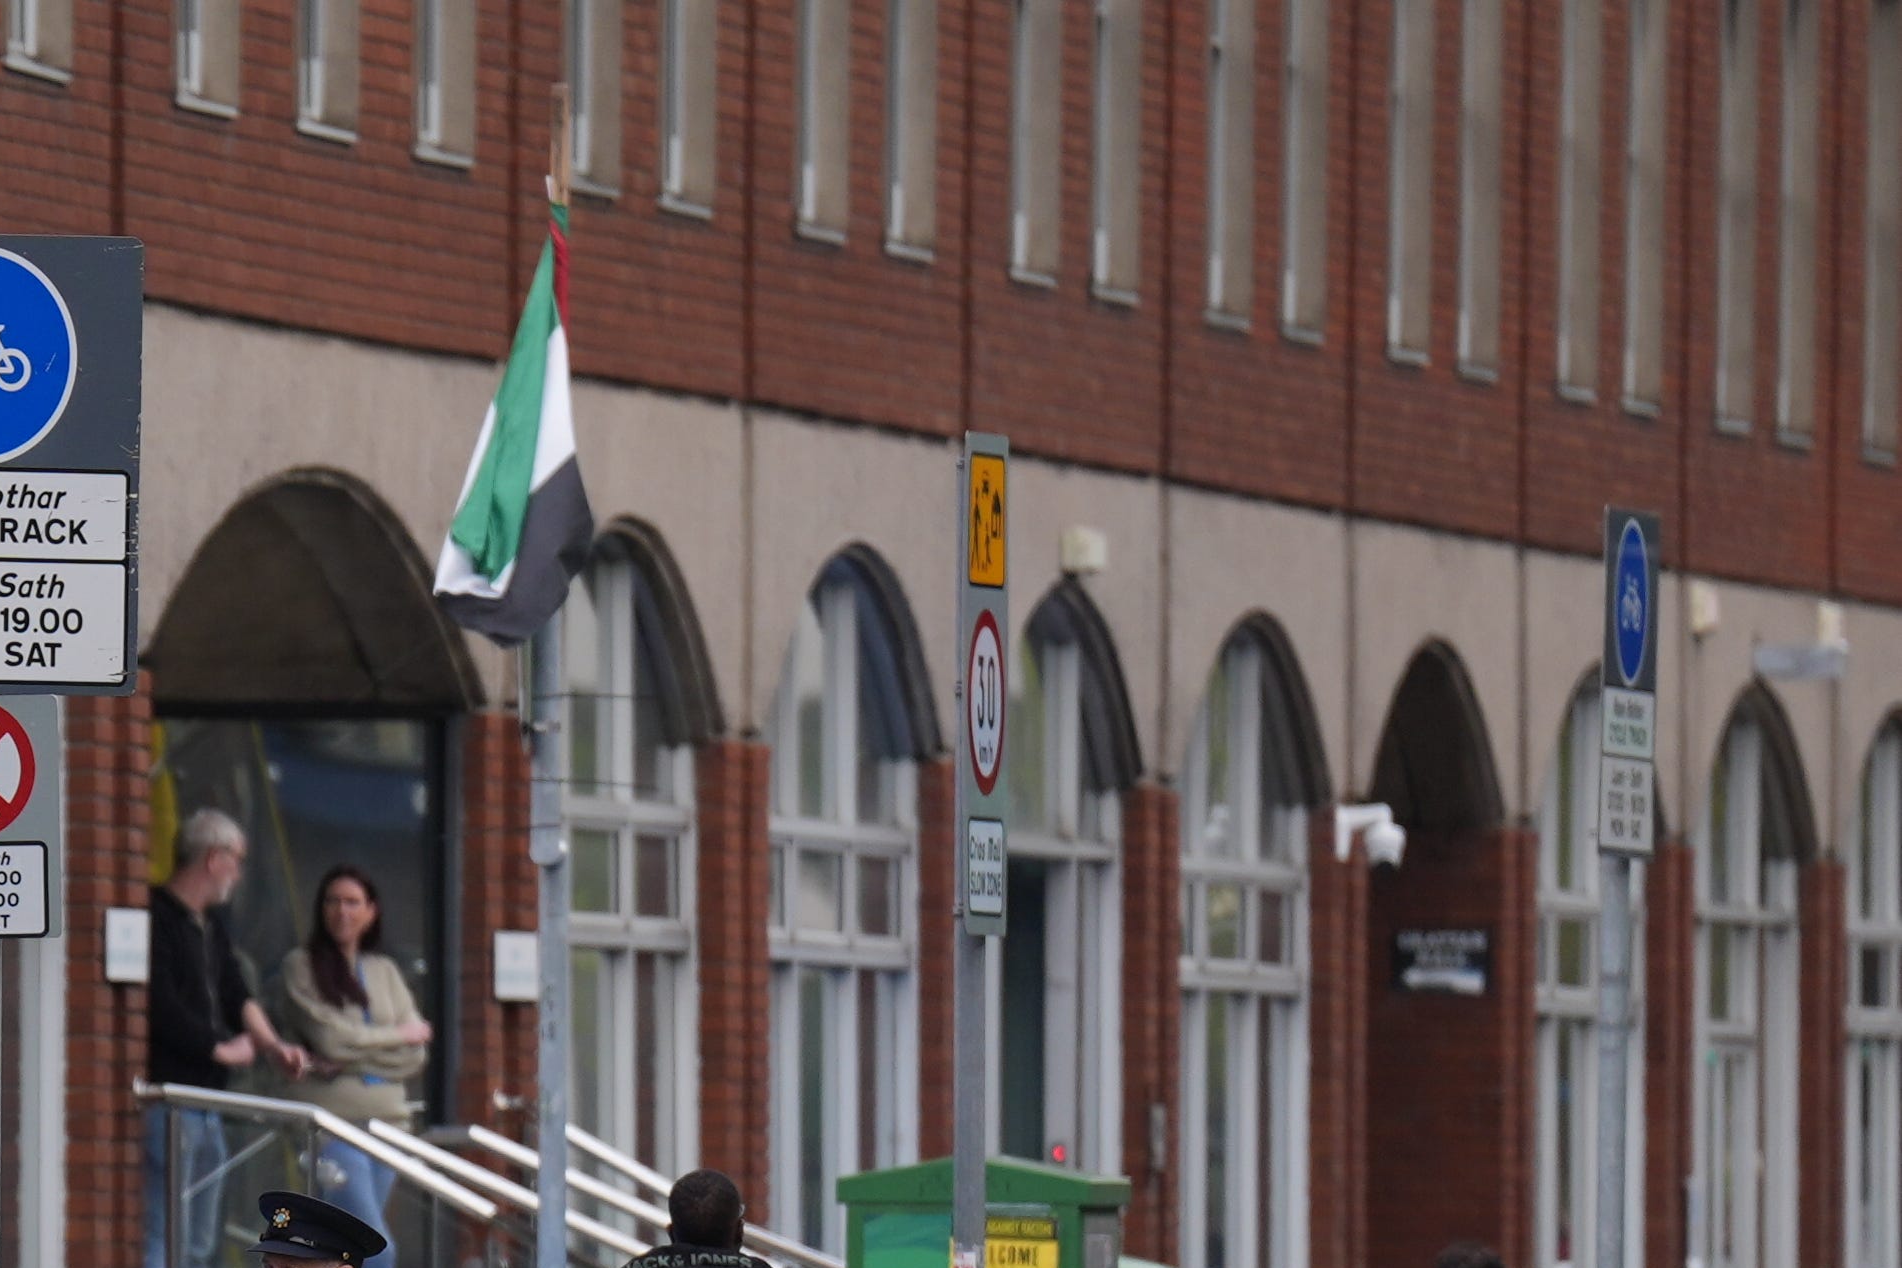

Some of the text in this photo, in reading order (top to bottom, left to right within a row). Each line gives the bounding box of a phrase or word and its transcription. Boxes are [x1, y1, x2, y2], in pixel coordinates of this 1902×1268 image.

[0, 607, 84, 634] 19.00
[5, 642, 62, 667] SAT
[978, 655, 995, 730] 30
